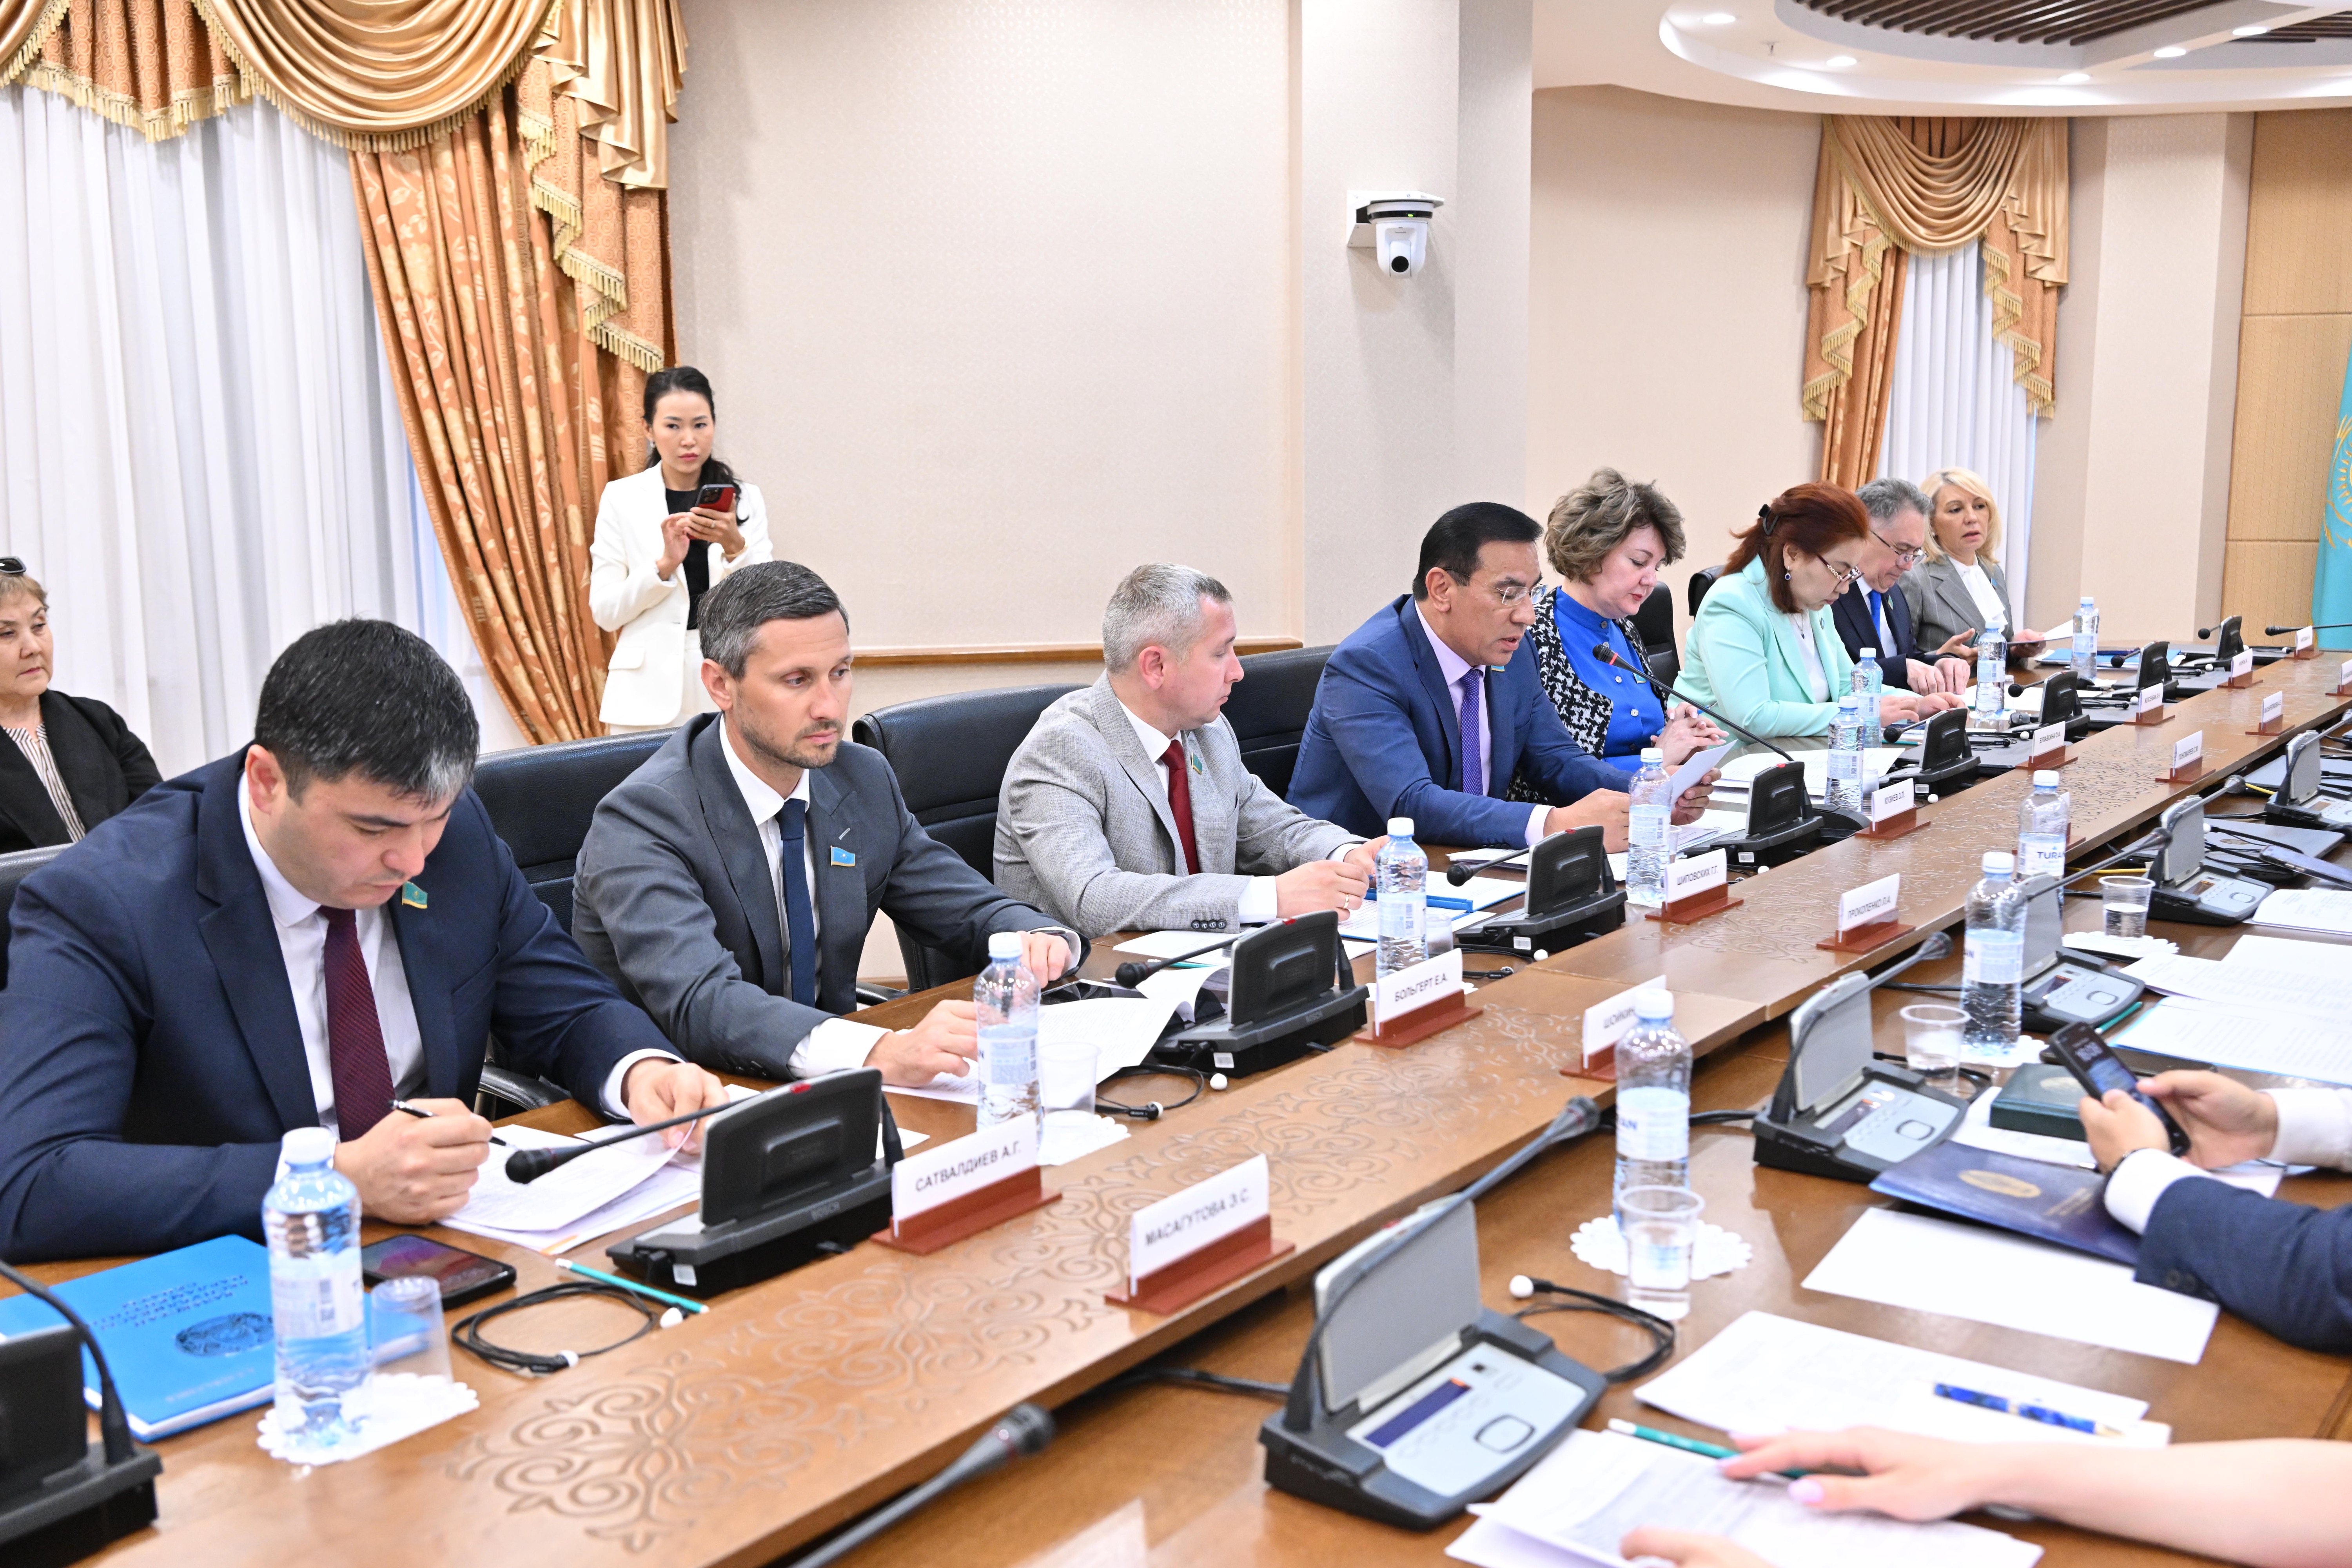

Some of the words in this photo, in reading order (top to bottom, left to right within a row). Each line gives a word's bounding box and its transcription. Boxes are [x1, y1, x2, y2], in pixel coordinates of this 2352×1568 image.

[2040, 733, 2055, 744] БУЛАВКИНА
[1885, 793, 1898, 804] КУЗИЕВ
[1677, 867, 1710, 886] ШИПОВСКИХ
[1847, 898, 1882, 920] ПРОКОПЕНКО
[1395, 977, 1433, 1002] БОЛЬГЕРТ
[915, 1149, 998, 1192] САТВАЛДИЕВ
[1001, 1140, 1022, 1159] А.Г.
[1144, 1199, 1227, 1247] МАСАГУТОВА
